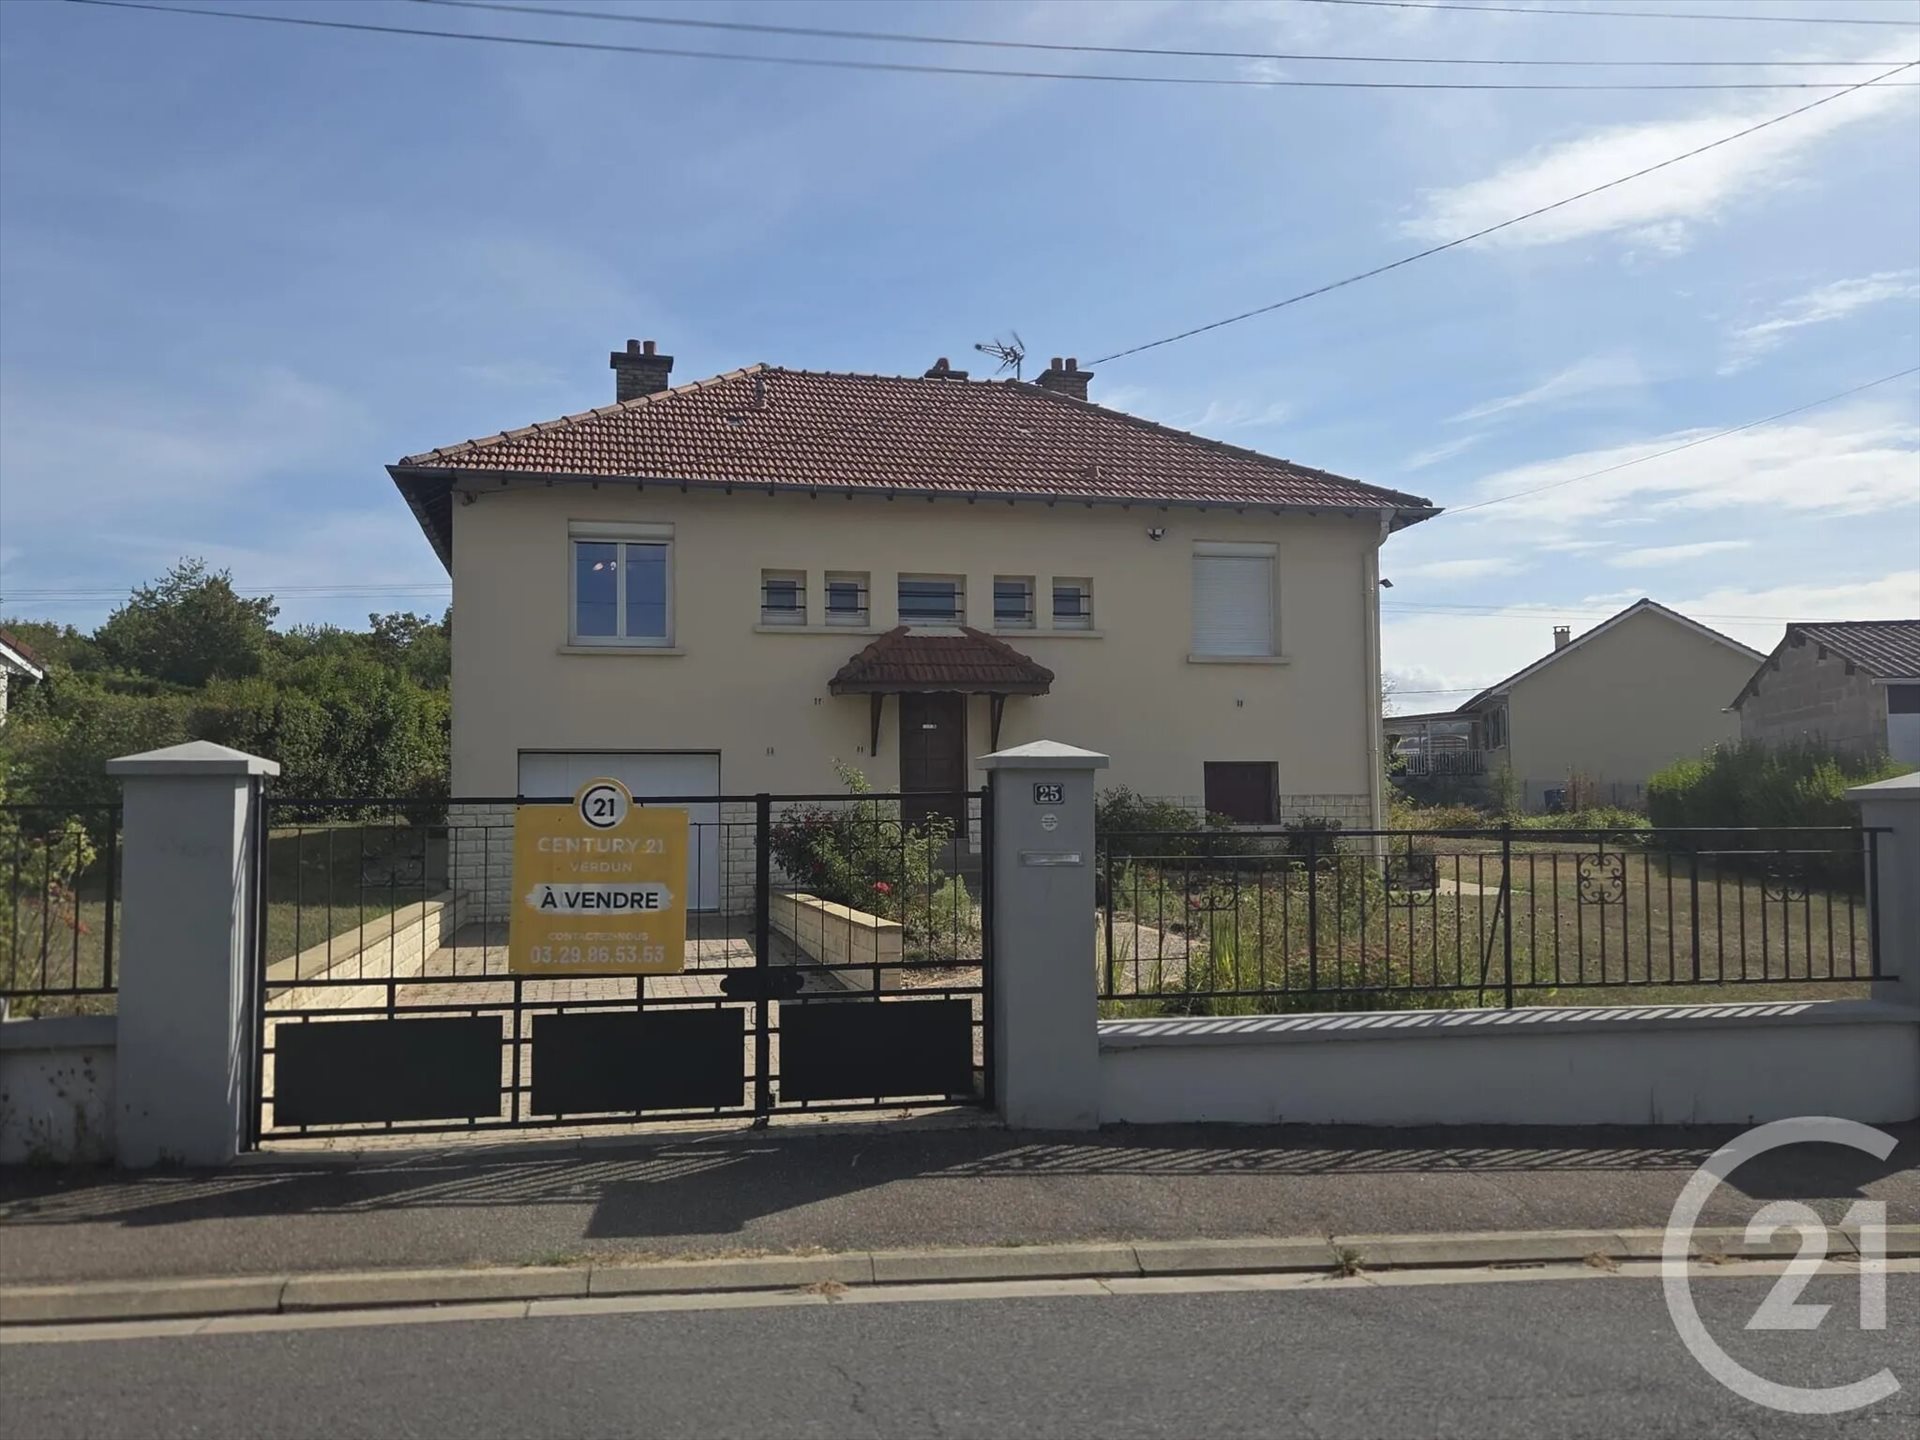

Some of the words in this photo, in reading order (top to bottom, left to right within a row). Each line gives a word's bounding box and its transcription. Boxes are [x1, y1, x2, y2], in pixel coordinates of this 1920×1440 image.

[1039, 786, 1060, 801] 25
[538, 837, 641, 853] CENTURY
[645, 839, 664, 854] 21
[570, 861, 633, 873] VERDUN
[541, 886, 558, 908] À
[565, 891, 659, 909] VENDRE
